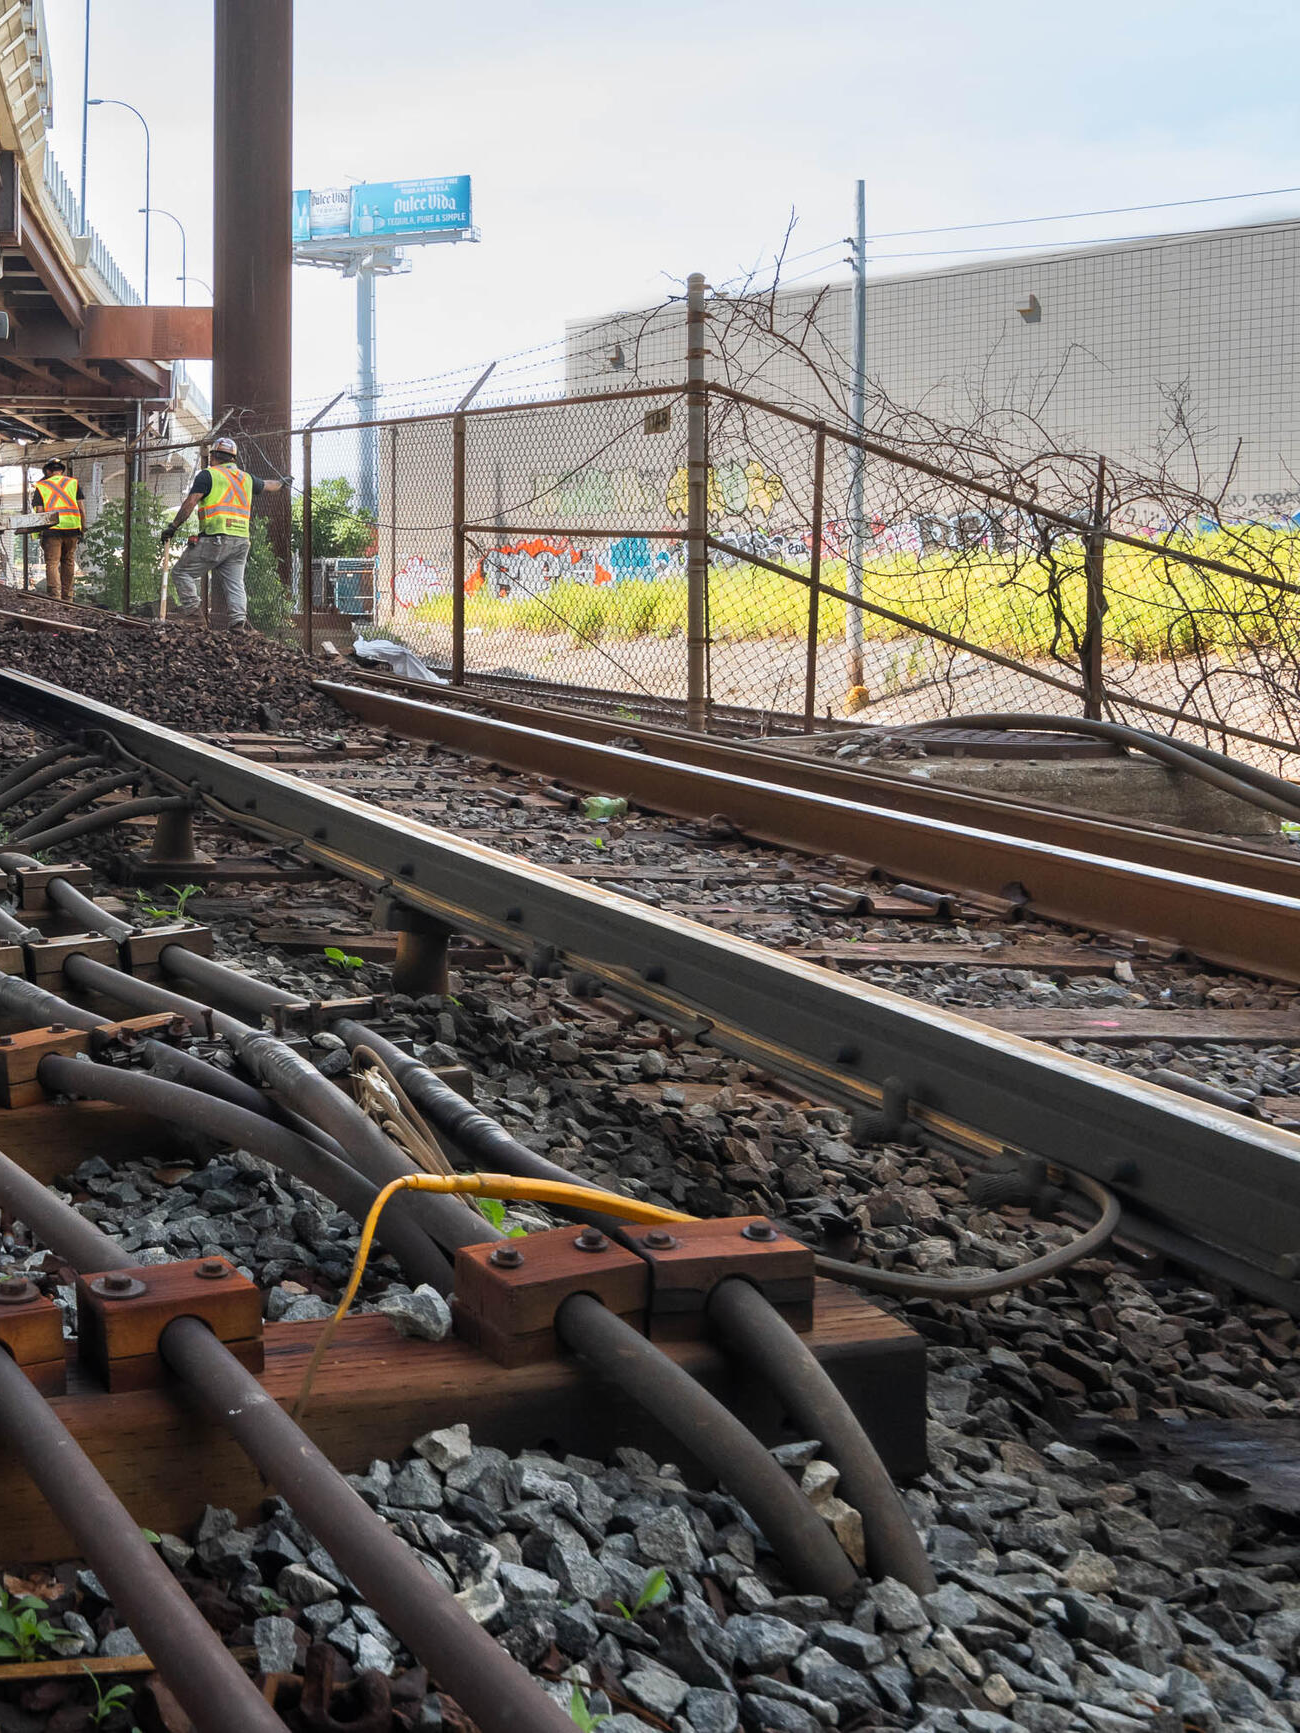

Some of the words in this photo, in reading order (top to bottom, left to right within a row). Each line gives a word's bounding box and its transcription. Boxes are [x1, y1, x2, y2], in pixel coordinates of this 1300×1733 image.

[394, 195, 426, 214] Dulce
[428, 193, 456, 210] Vida
[417, 214, 434, 223] PURE
[442, 212, 466, 222] SIMPLE
